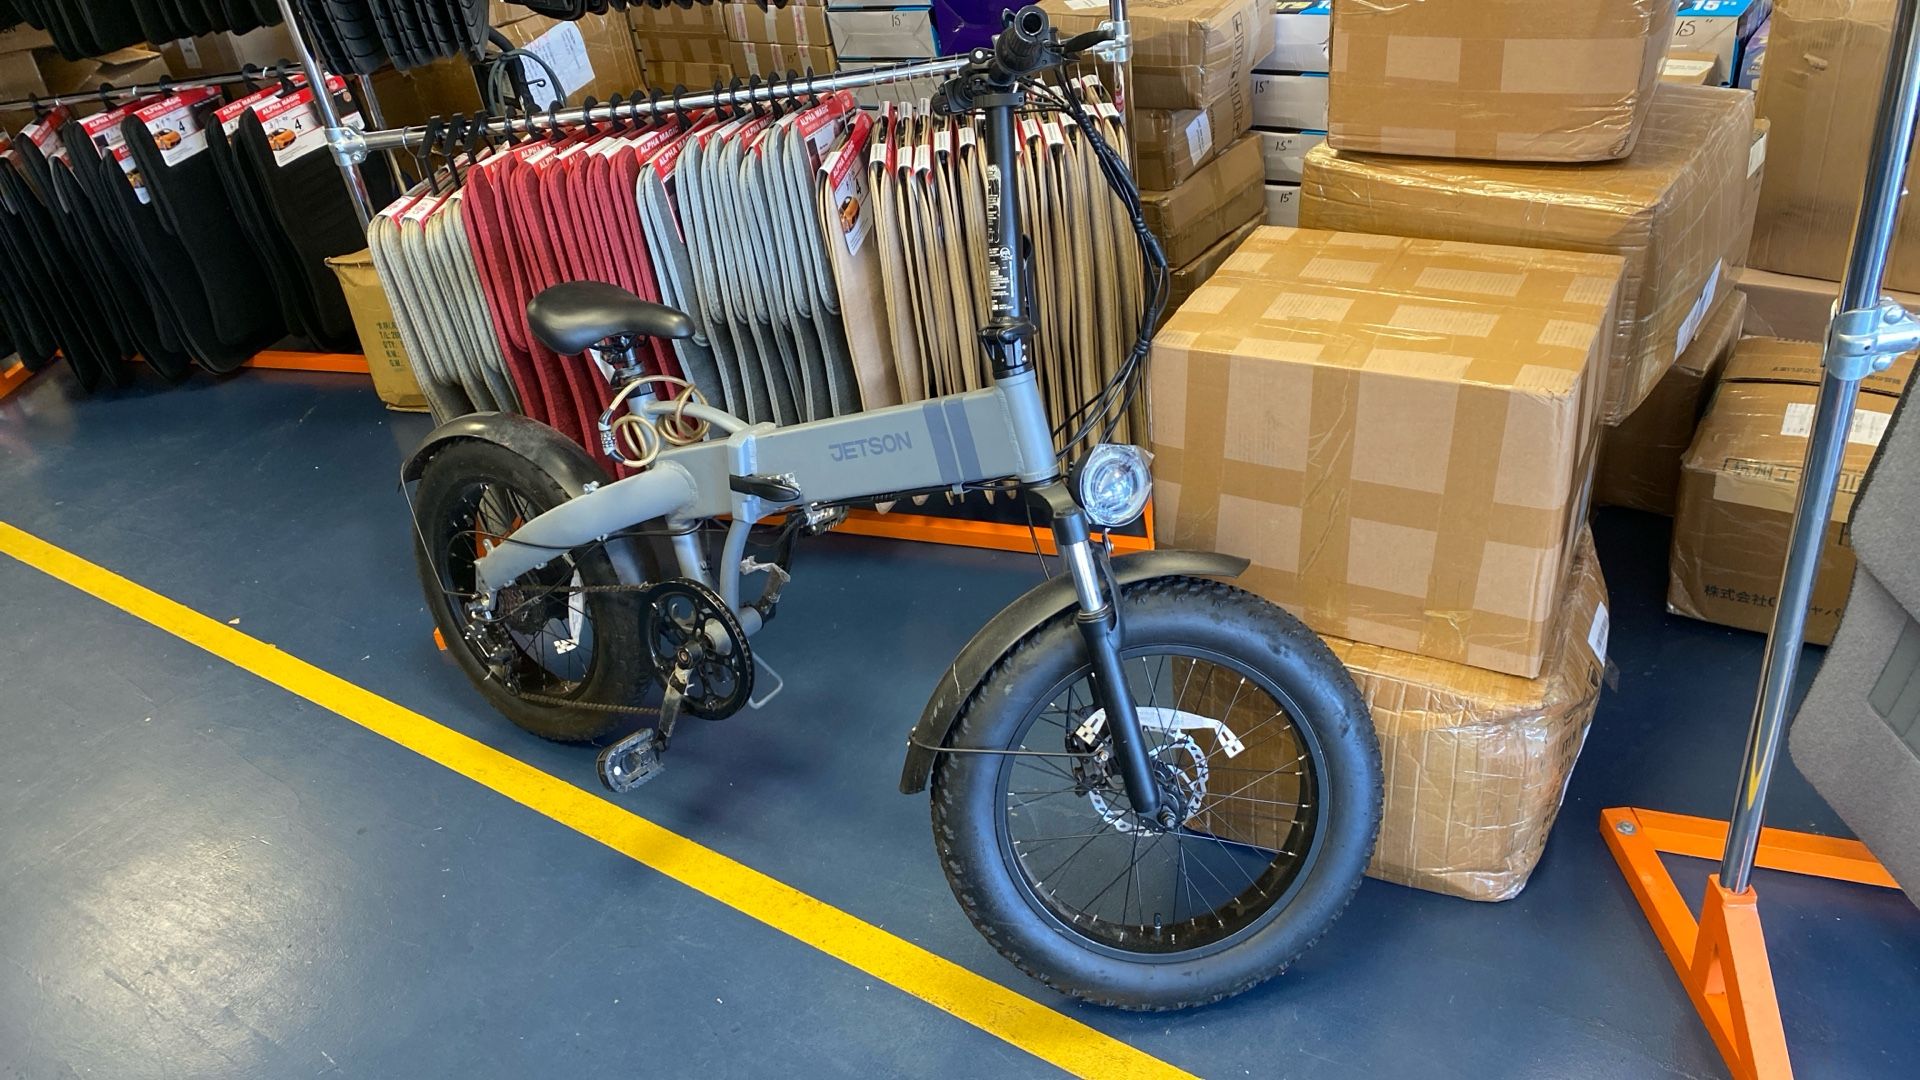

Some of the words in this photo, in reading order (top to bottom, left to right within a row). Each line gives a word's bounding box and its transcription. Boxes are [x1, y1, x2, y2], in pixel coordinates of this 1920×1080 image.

[1675, 19, 1713, 37] 15"
[1254, 79, 1270, 95] 15"
[262, 102, 282, 116] ALPHA
[281, 93, 301, 106] MAGIC
[178, 120, 186, 132] 4
[294, 118, 303, 131] 4
[640, 138, 660, 155] ALPHA
[659, 125, 679, 142] MAGIC
[1275, 139, 1293, 152] 15"
[521, 146, 540, 159] ALPHA
[658, 147, 679, 167] ALPHA
[1280, 191, 1293, 203] 15"
[828, 431, 912, 462] JETSON
